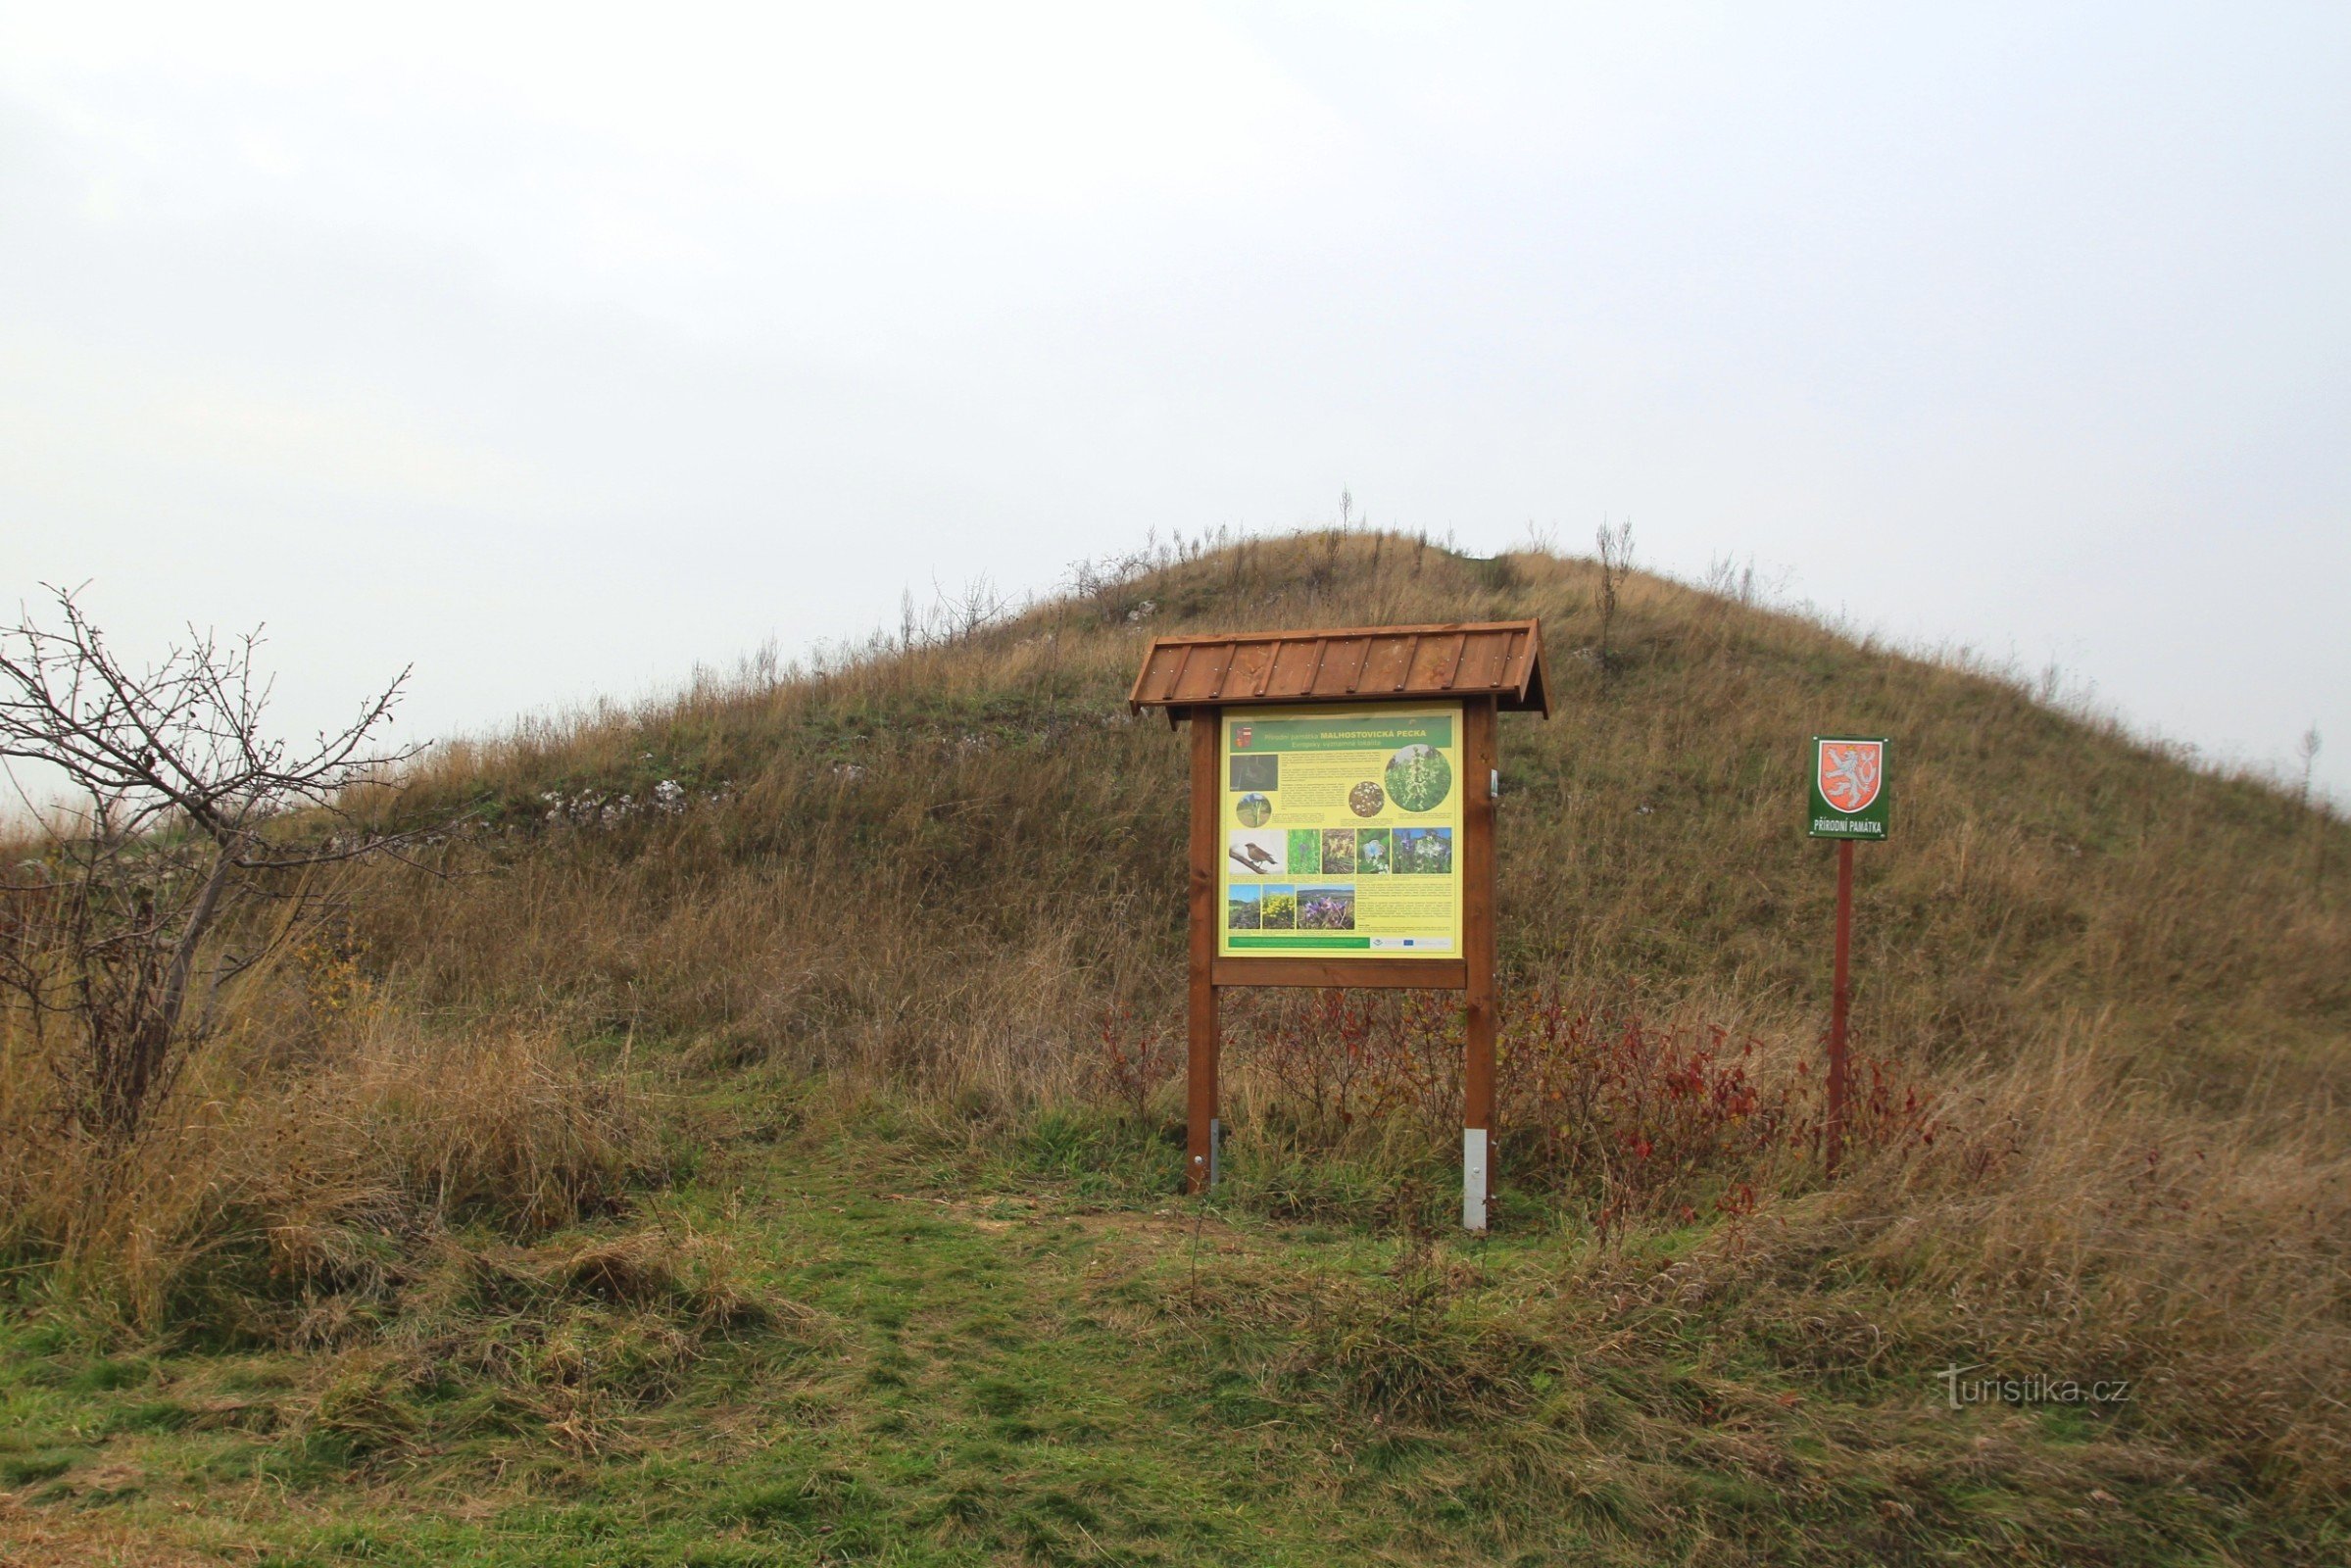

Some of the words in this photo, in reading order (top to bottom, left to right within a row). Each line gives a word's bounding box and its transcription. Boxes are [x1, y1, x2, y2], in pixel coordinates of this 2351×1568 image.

[1396, 729, 1427, 738] PECKA
[1814, 816, 1848, 832] PŘÍRODNÍ
[1849, 817, 1882, 833] PAMÁTKA
